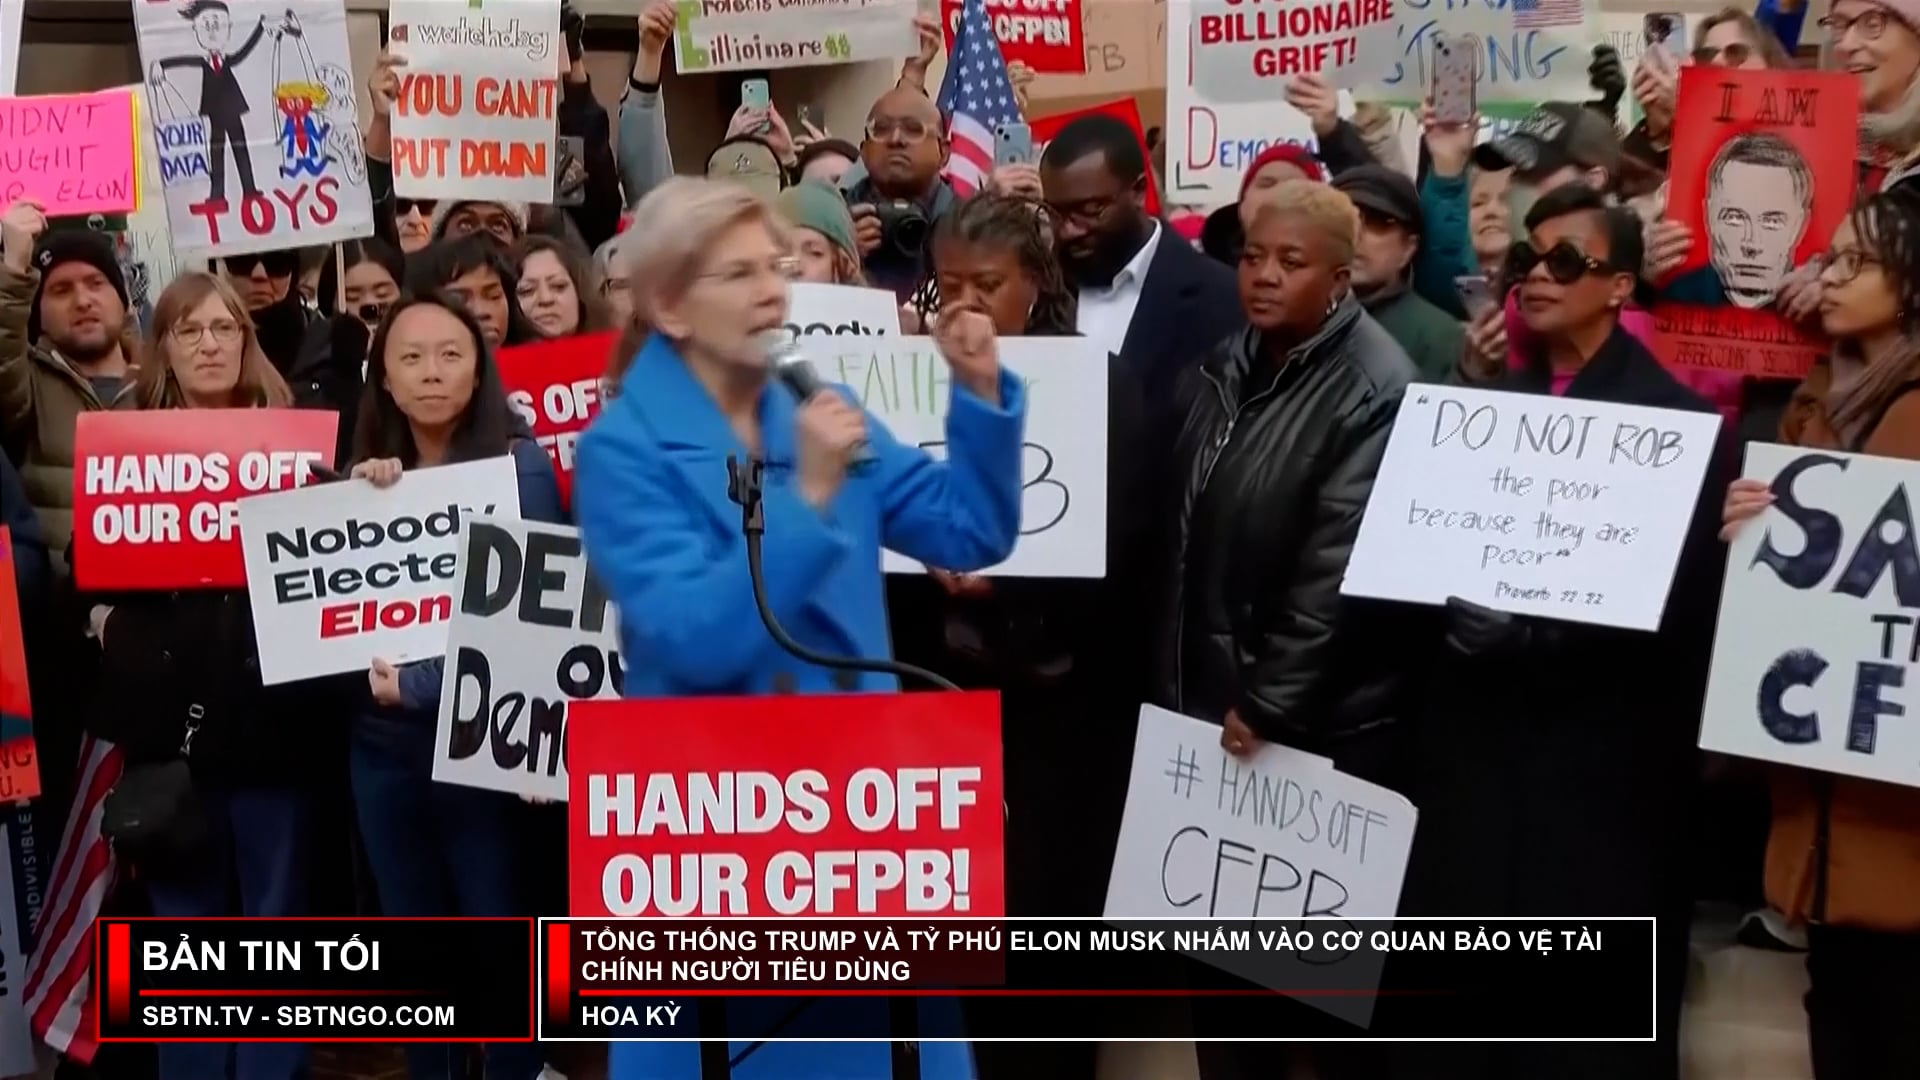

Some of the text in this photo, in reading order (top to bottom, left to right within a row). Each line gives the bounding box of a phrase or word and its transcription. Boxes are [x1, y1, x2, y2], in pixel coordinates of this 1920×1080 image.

[418, 17, 549, 61] watchdog
[1201, 1, 1394, 44] BILLIONAIRE
[1254, 37, 1357, 77] GRIFT!
[396, 74, 462, 117] YOU
[0, 102, 109, 141] IDN'T
[156, 121, 204, 150] YOUR
[0, 144, 99, 174] UGHT
[160, 152, 210, 182] DATA
[392, 138, 451, 178] PUT
[460, 139, 546, 178] DOWN
[56, 171, 129, 201] ELON
[189, 176, 339, 245] TOYS
[1513, 413, 1598, 460] NOT
[1608, 422, 1684, 468] ROB
[86, 452, 230, 495] HANDS
[1490, 466, 1609, 506] the poor
[93, 503, 181, 545] OUR
[1408, 499, 1640, 547] because they are
[274, 553, 456, 604] Electe
[320, 594, 452, 639] Elon
[588, 767, 982, 837] HANDS OFF
[602, 848, 971, 917] OUR CFPB!
[1162, 826, 1358, 966] CFPB
